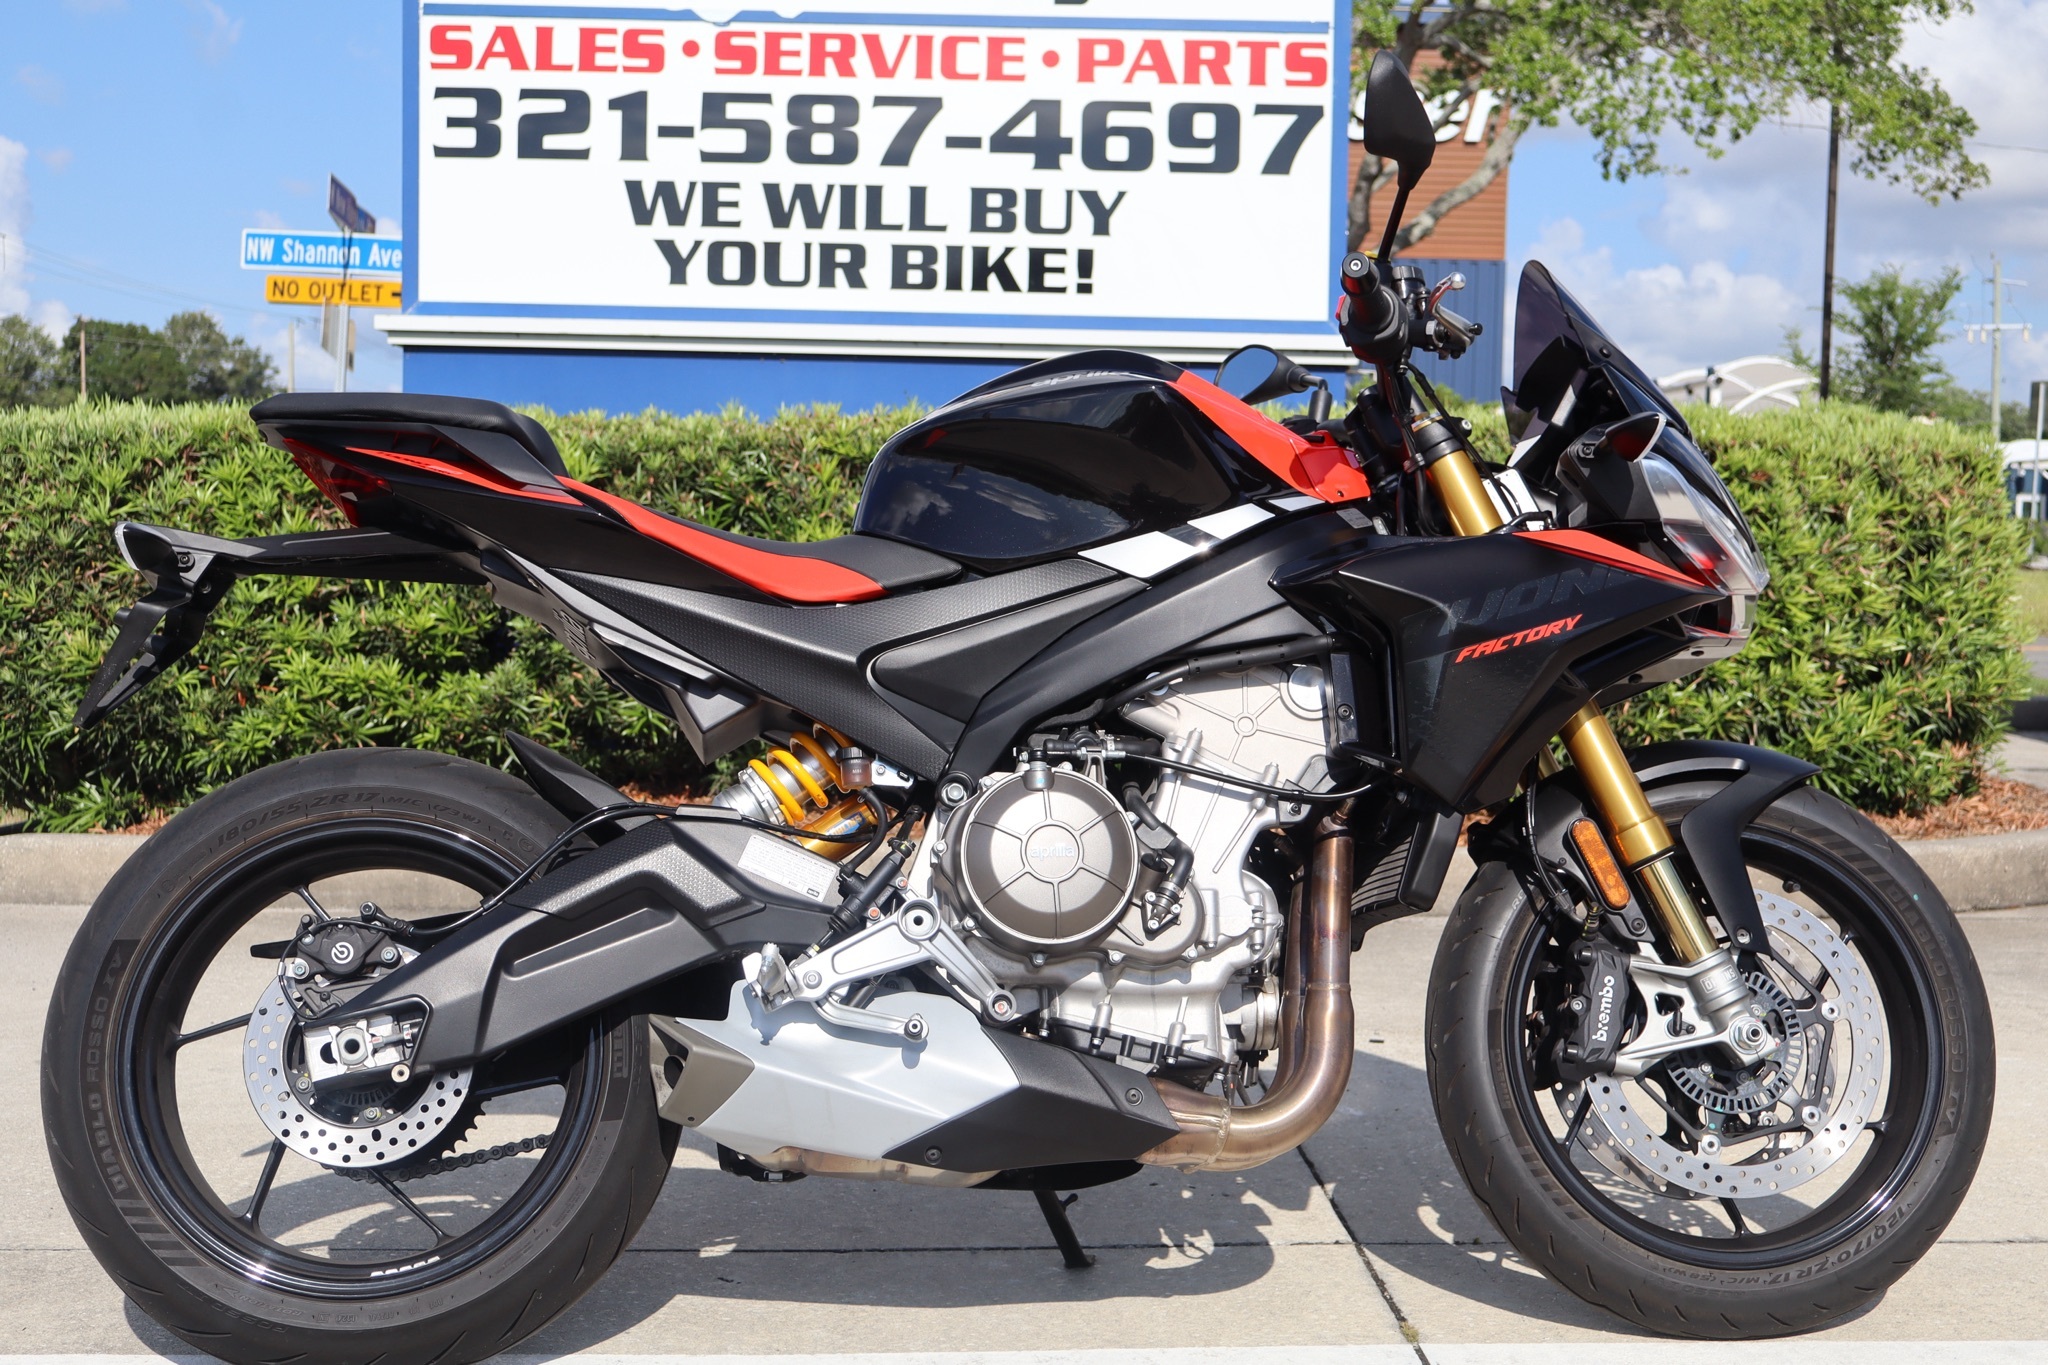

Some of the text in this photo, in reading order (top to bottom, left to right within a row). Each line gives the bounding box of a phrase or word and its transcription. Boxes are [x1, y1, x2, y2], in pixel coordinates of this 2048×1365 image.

[430, 25, 1328, 87] SALES SERVICE PARTS
[433, 86, 1324, 175] 321-587-4697
[624, 180, 1127, 236] WE WILL BUY
[246, 237, 402, 269] NW Shannon Ave
[653, 239, 1094, 294] YOUR BIKE!
[271, 280, 384, 303] NO OUTLET
[1455, 613, 1584, 664] FACTORY
[1030, 842, 1075, 861] aprilia
[1592, 975, 1616, 1042] brembo
[85, 996, 109, 1083] ROSSO
[87, 1091, 130, 1195] DIABLO
